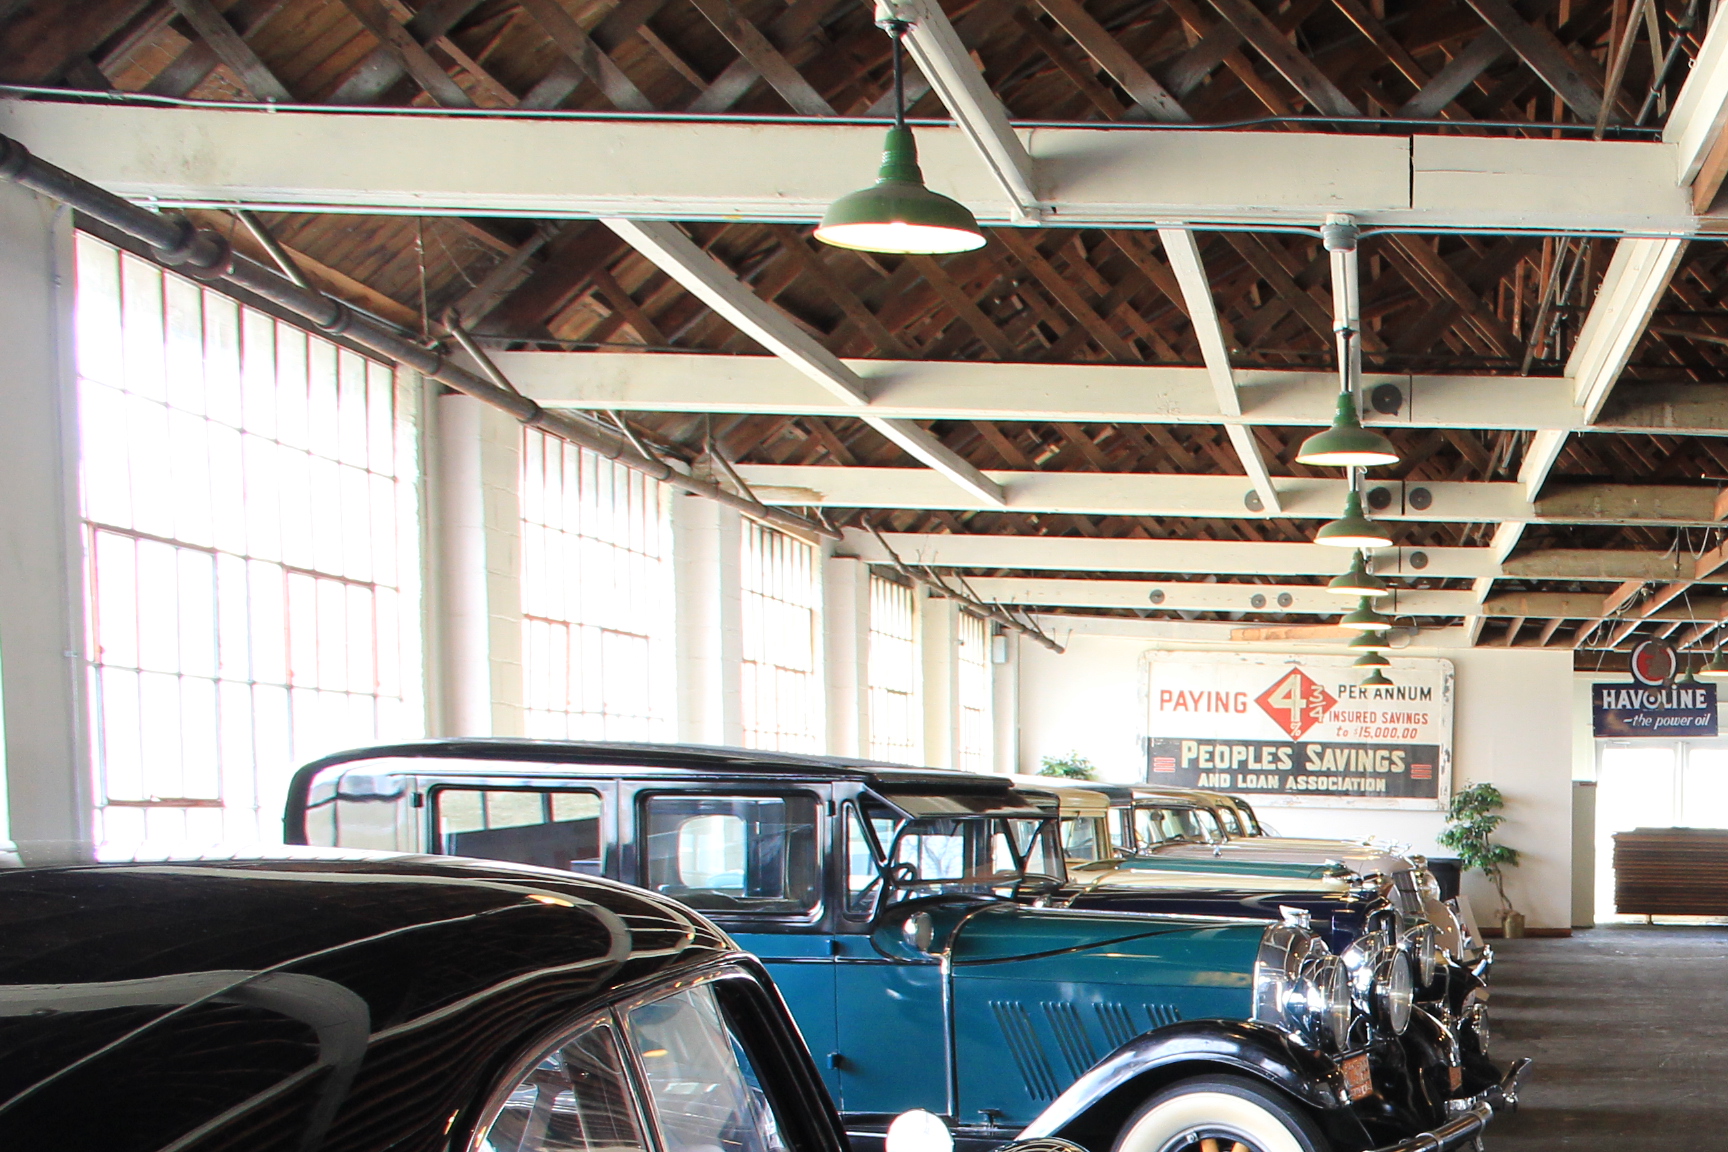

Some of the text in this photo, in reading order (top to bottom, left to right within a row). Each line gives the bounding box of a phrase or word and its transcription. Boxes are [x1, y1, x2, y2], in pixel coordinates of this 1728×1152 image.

[1159, 689, 1249, 714] PAYING
[1337, 684, 1432, 702] PER ANNUM
[1602, 684, 1708, 710] HAVOLINE
[1328, 710, 1429, 725] INSURED SAVINGS
[1653, 716, 1694, 730] power
[1694, 713, 1711, 726] oil
[1336, 726, 1349, 738] to
[1181, 740, 1406, 773] PEOPLES SAVINGS
[1197, 772, 1387, 793] AND LOAN ASSOCIATION
